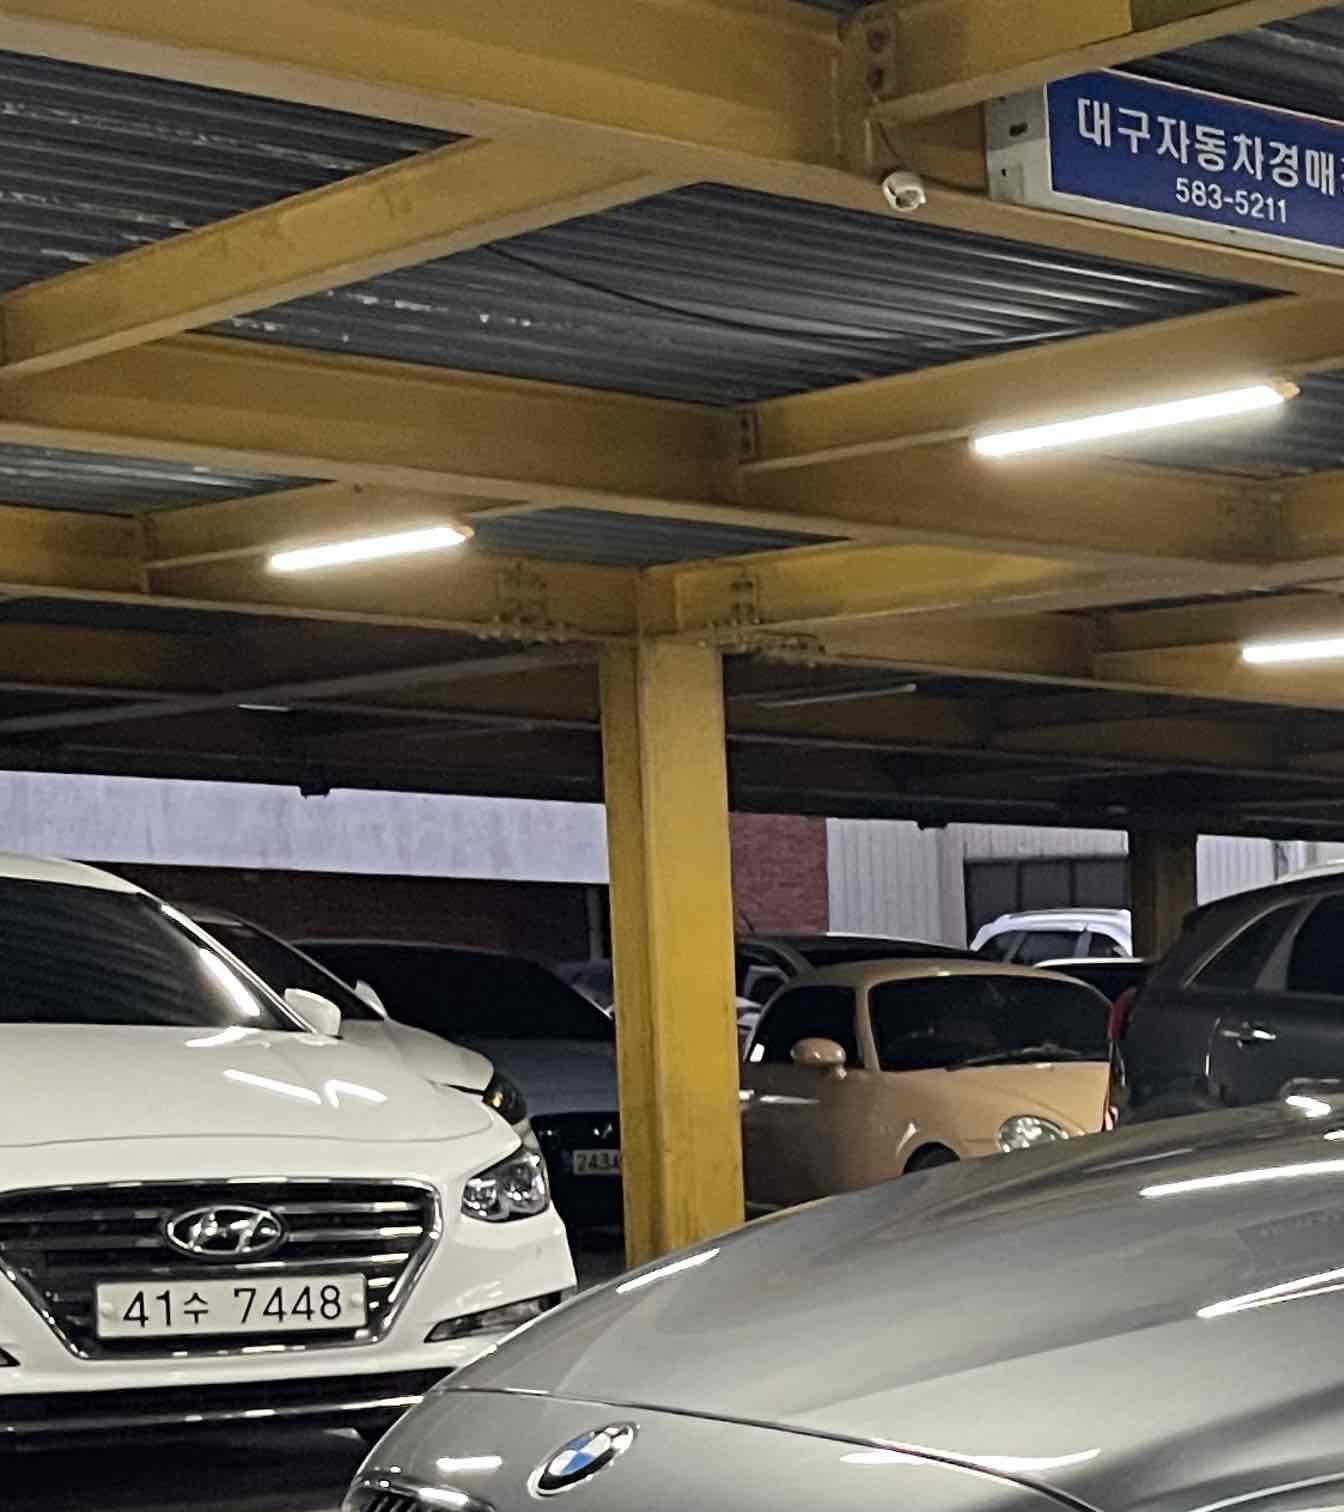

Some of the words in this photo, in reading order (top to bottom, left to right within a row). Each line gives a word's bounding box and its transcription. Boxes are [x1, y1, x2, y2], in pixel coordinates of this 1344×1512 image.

[1175, 176, 1287, 224] 583-5211
[121, 1289, 209, 1328] 41수
[233, 1284, 342, 1324] 7448
